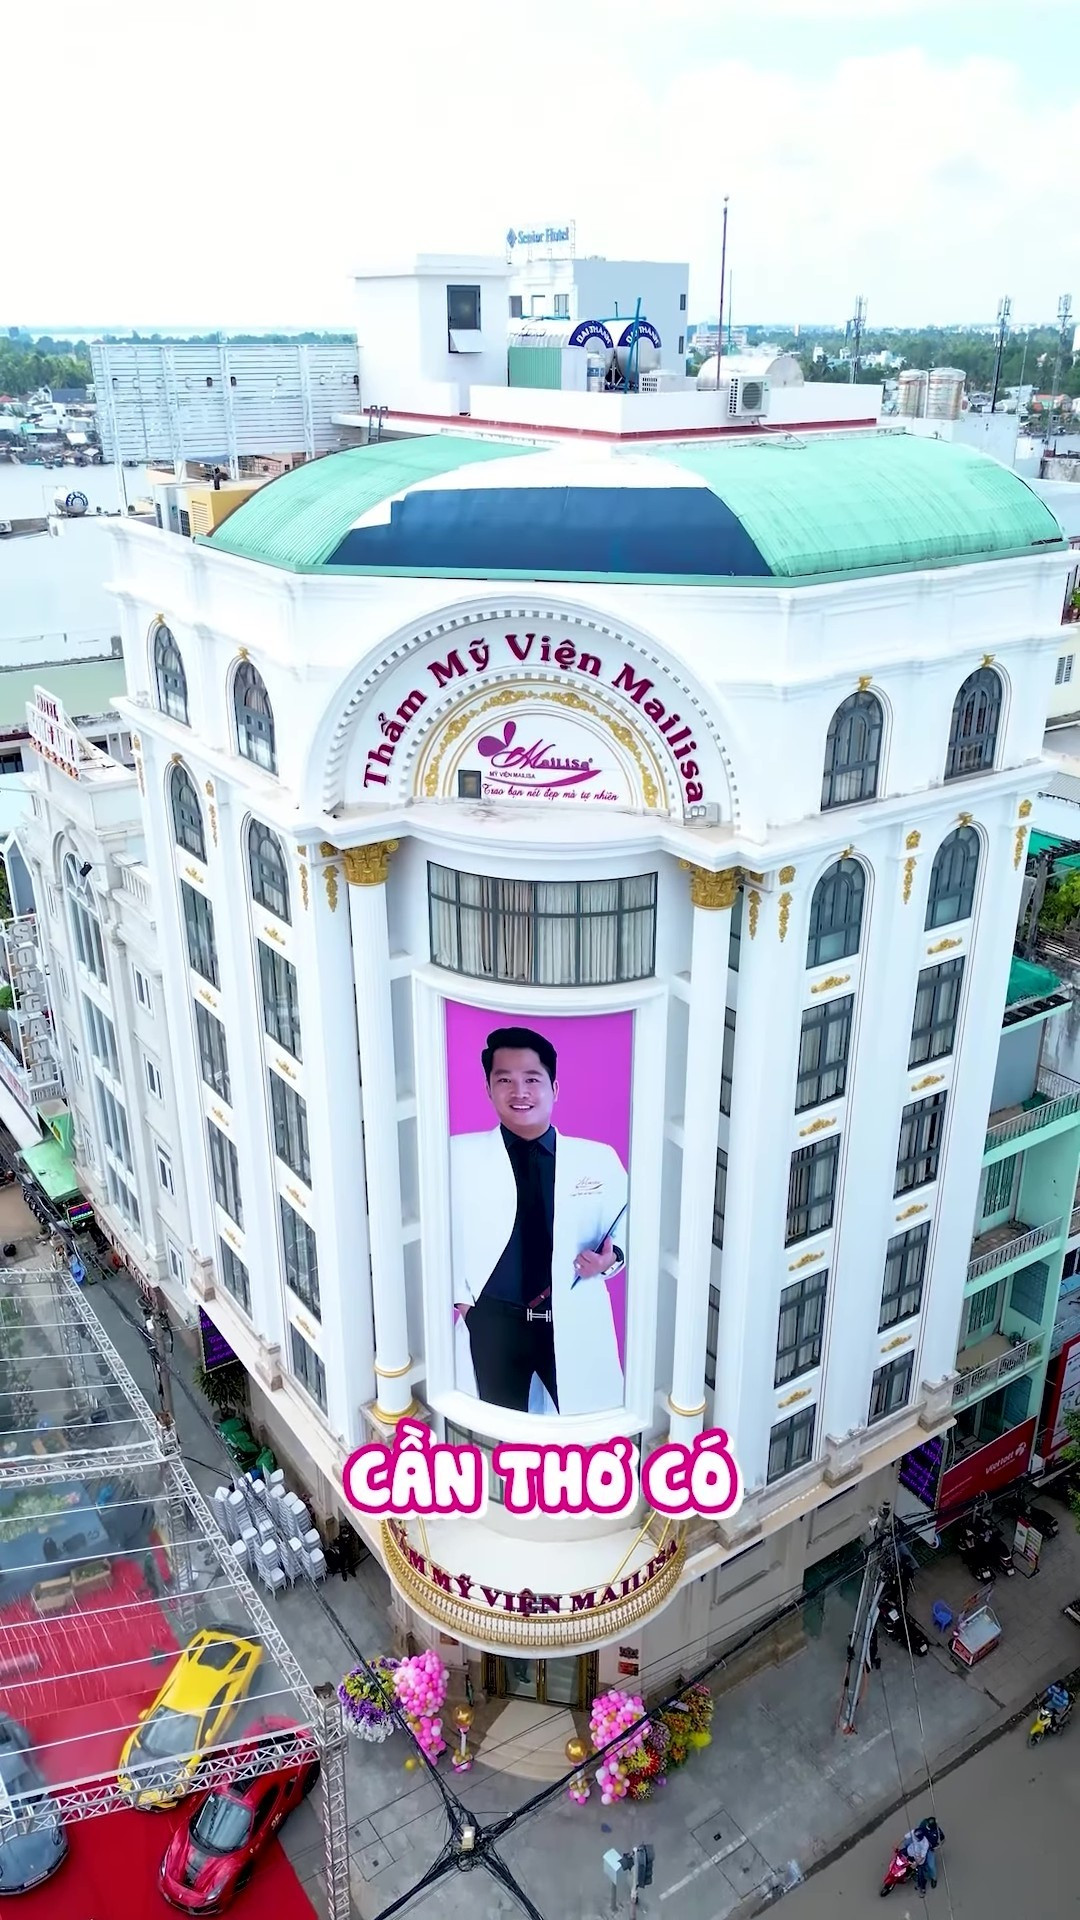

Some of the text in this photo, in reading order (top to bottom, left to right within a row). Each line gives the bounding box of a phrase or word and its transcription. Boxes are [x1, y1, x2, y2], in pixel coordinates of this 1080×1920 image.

[545, 226, 569, 242] Hotel
[363, 633, 704, 804] Thẩm Mỹ Viện Mailisa
[482, 783, 505, 796] Trao
[507, 785, 523, 799] bạn
[543, 787, 560, 800] đẹp
[593, 789, 619, 801] nhiên
[431, 1565, 475, 1600] MỸ
[480, 1586, 562, 1618] VIỆN
[570, 1540, 679, 1614] MAILISA
